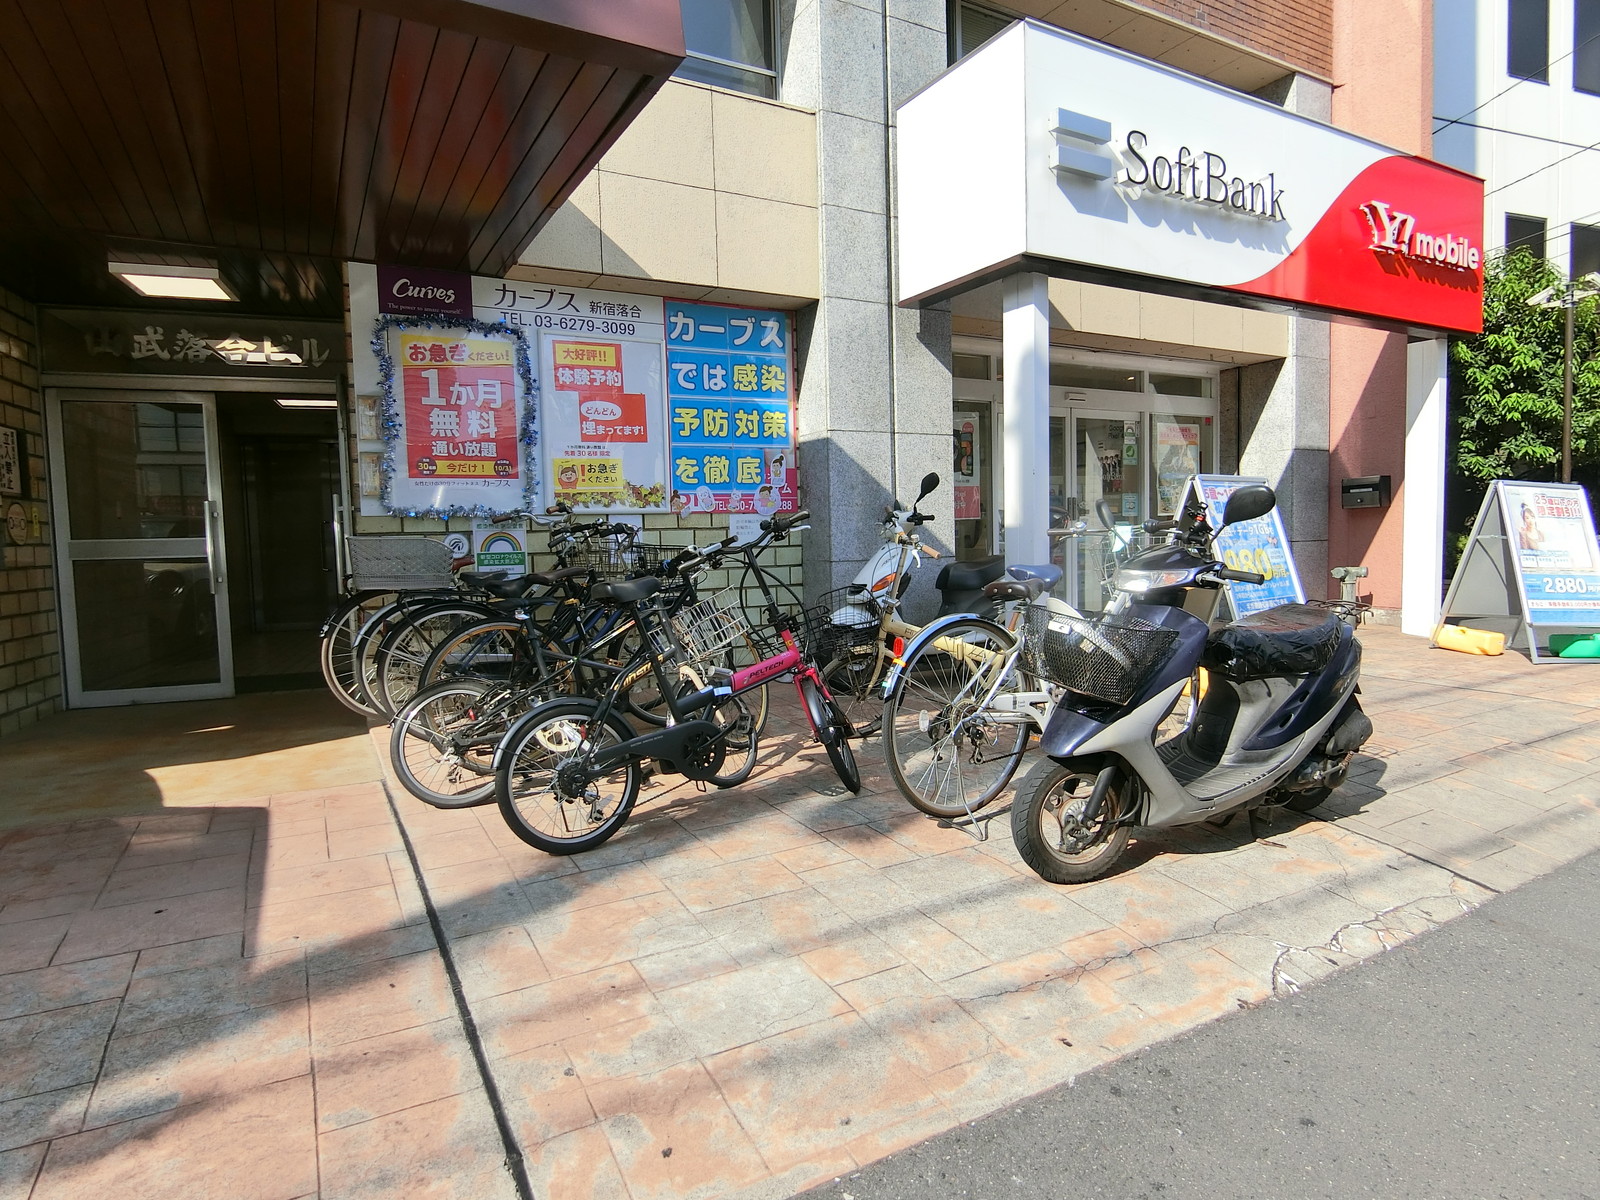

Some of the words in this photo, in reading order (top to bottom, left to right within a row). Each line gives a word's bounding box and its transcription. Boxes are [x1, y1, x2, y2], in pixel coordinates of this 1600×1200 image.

[1126, 129, 1287, 221] SoftBank
[392, 278, 456, 303] Curves
[494, 283, 581, 313] カーブス
[588, 300, 642, 319] 新宿落合
[669, 311, 784, 348] カーブス
[421, 368, 503, 409] 1か月
[557, 367, 622, 387] 体験予約
[671, 363, 786, 393] では感染
[429, 407, 498, 439] 無料
[585, 406, 617, 417] どんどん
[673, 407, 787, 438] 予防対策
[431, 440, 498, 457] 通い放題
[587, 463, 619, 474] お急ぎ
[588, 475, 618, 483] ください
[675, 455, 762, 484] を徹底
[482, 479, 511, 488] カーブス
[749, 660, 784, 678] PELTECH
